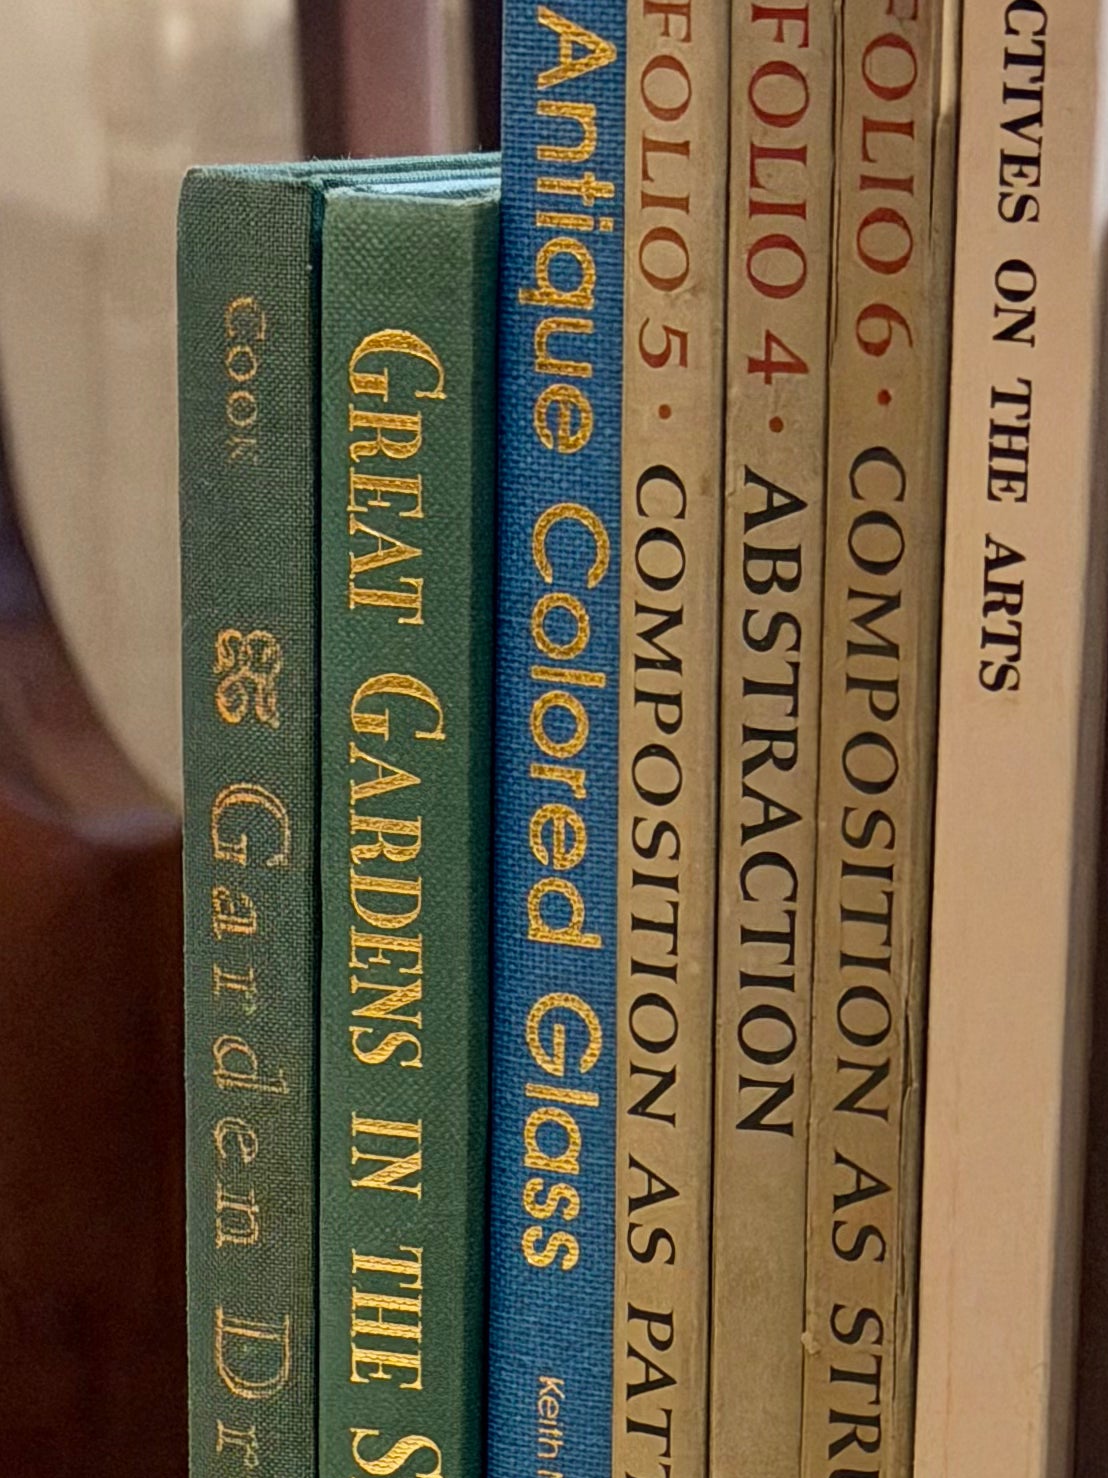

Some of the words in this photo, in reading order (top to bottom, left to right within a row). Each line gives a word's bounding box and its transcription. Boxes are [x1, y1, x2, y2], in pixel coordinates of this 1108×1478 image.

[639, 0, 692, 292] FOLIO
[746, 0, 810, 299] FOLIO
[998, 0, 1047, 223] CTIVES
[518, 6, 617, 453] Antique
[856, 303, 913, 357] 6
[993, 259, 1036, 347] ON
[639, 318, 687, 368] 5
[747, 330, 809, 385] 4
[988, 378, 1032, 502] THE
[347, 329, 446, 624] GREAT
[979, 534, 1025, 691] ARTS
[527, 502, 611, 949] Colored
[627, 464, 686, 1127] COMPOSITION
[736, 465, 808, 1138] ABSTRACTION
[833, 445, 906, 1122] COMPOSITION
[349, 673, 445, 1068] GARDENS
[210, 782, 292, 1250] Garden
[351, 1112, 422, 1199] IN
[521, 992, 602, 1270] Glass
[627, 1154, 679, 1265] AS
[832, 1150, 891, 1262] AS
[350, 1246, 422, 1390] THE
[538, 1376, 565, 1458] Keith
